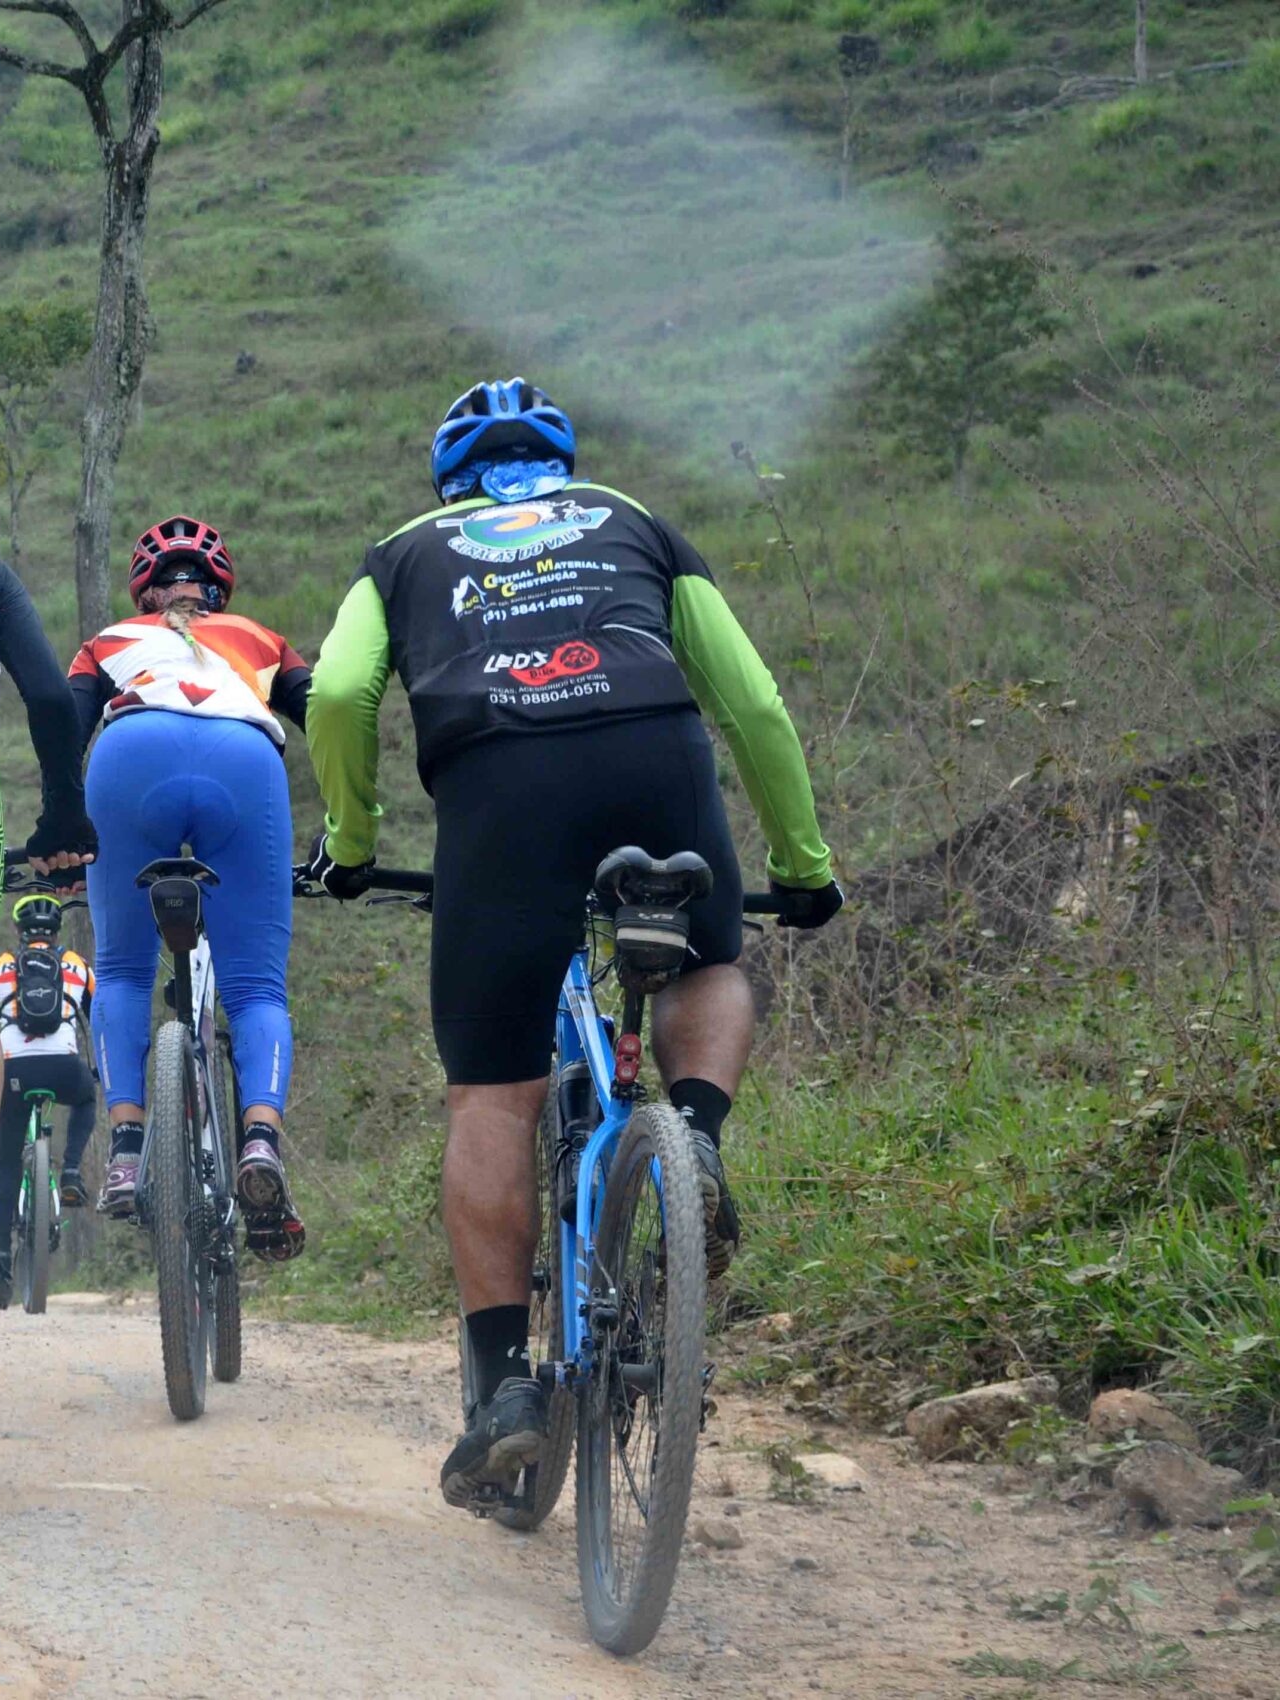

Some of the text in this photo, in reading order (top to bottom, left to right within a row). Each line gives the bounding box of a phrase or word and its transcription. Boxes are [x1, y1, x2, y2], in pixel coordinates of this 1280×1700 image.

[518, 542, 544, 561] DO
[536, 558, 599, 575] MATERIAL
[522, 681, 610, 705] 98804-0570
